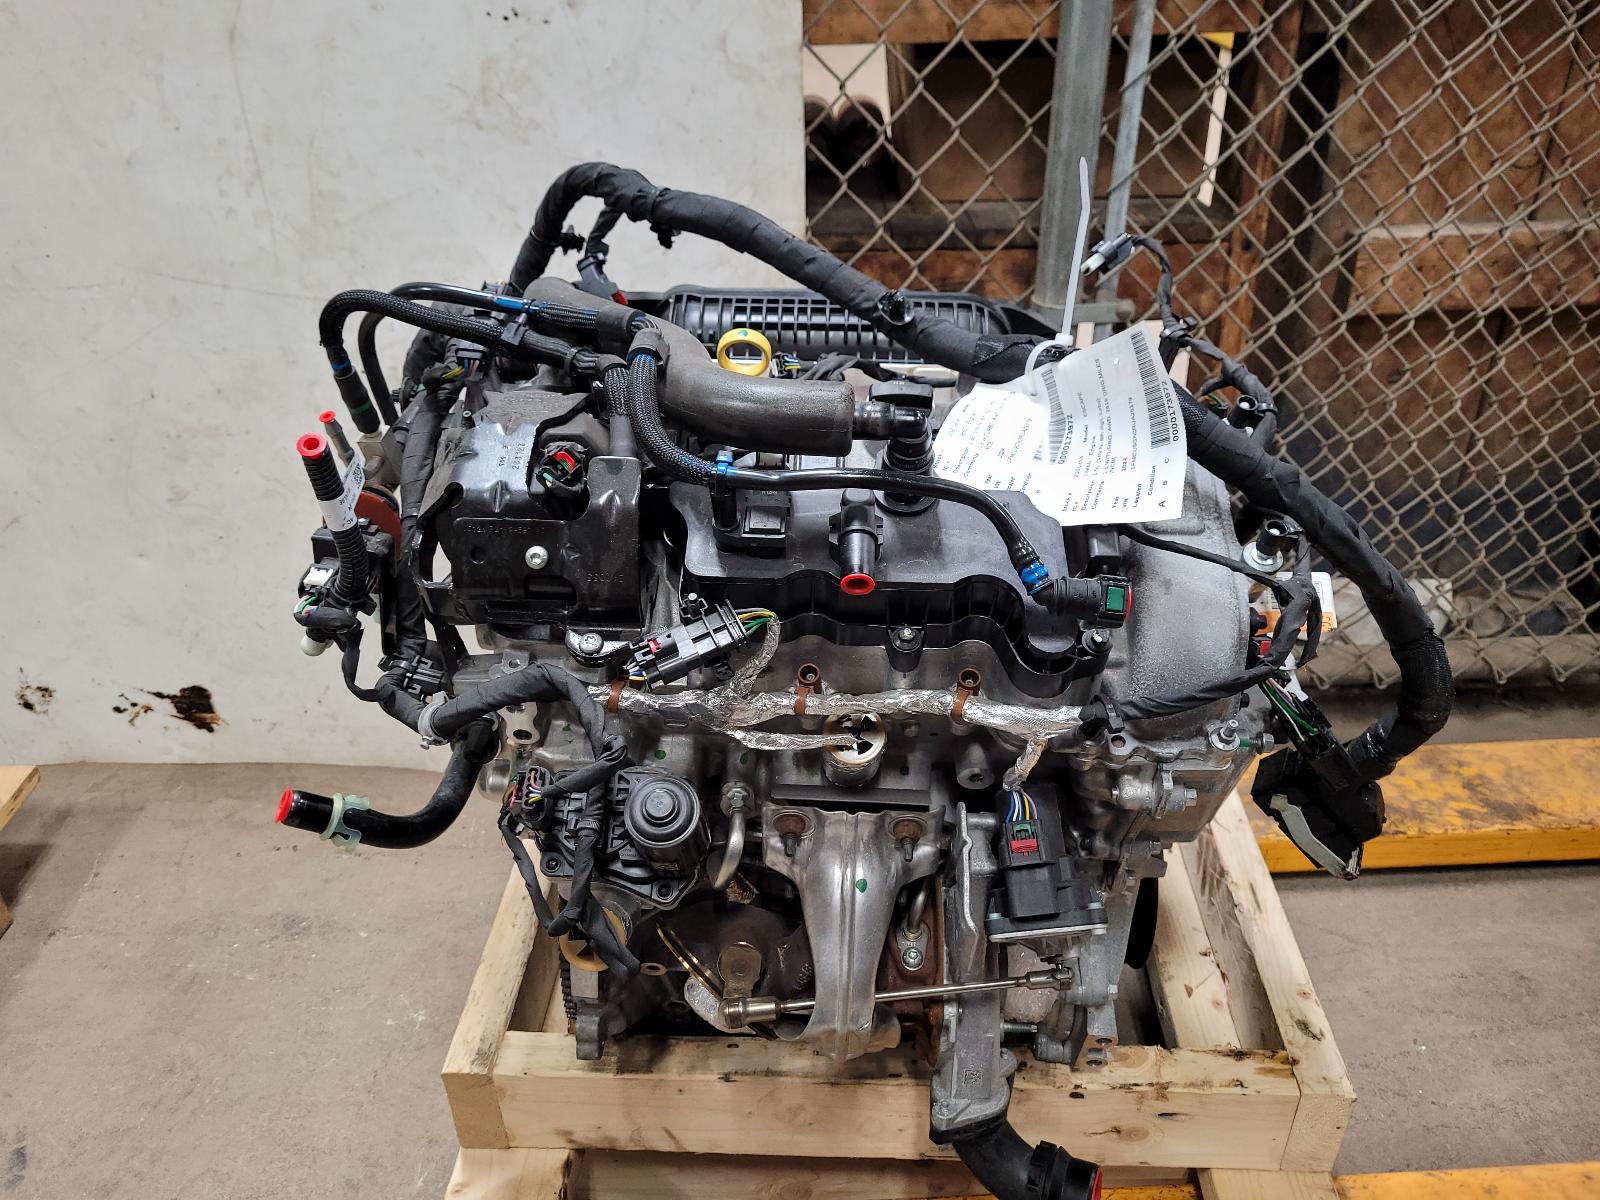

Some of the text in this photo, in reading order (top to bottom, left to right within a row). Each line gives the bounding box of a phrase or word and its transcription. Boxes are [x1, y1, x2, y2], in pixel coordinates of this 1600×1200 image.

[1077, 391, 1088, 418] ESCAPE
[1161, 379, 1180, 442] 0000173972
[1057, 413, 1074, 465] 0000173972
[1147, 465, 1156, 496] Condition
[1158, 499, 1167, 508] A
